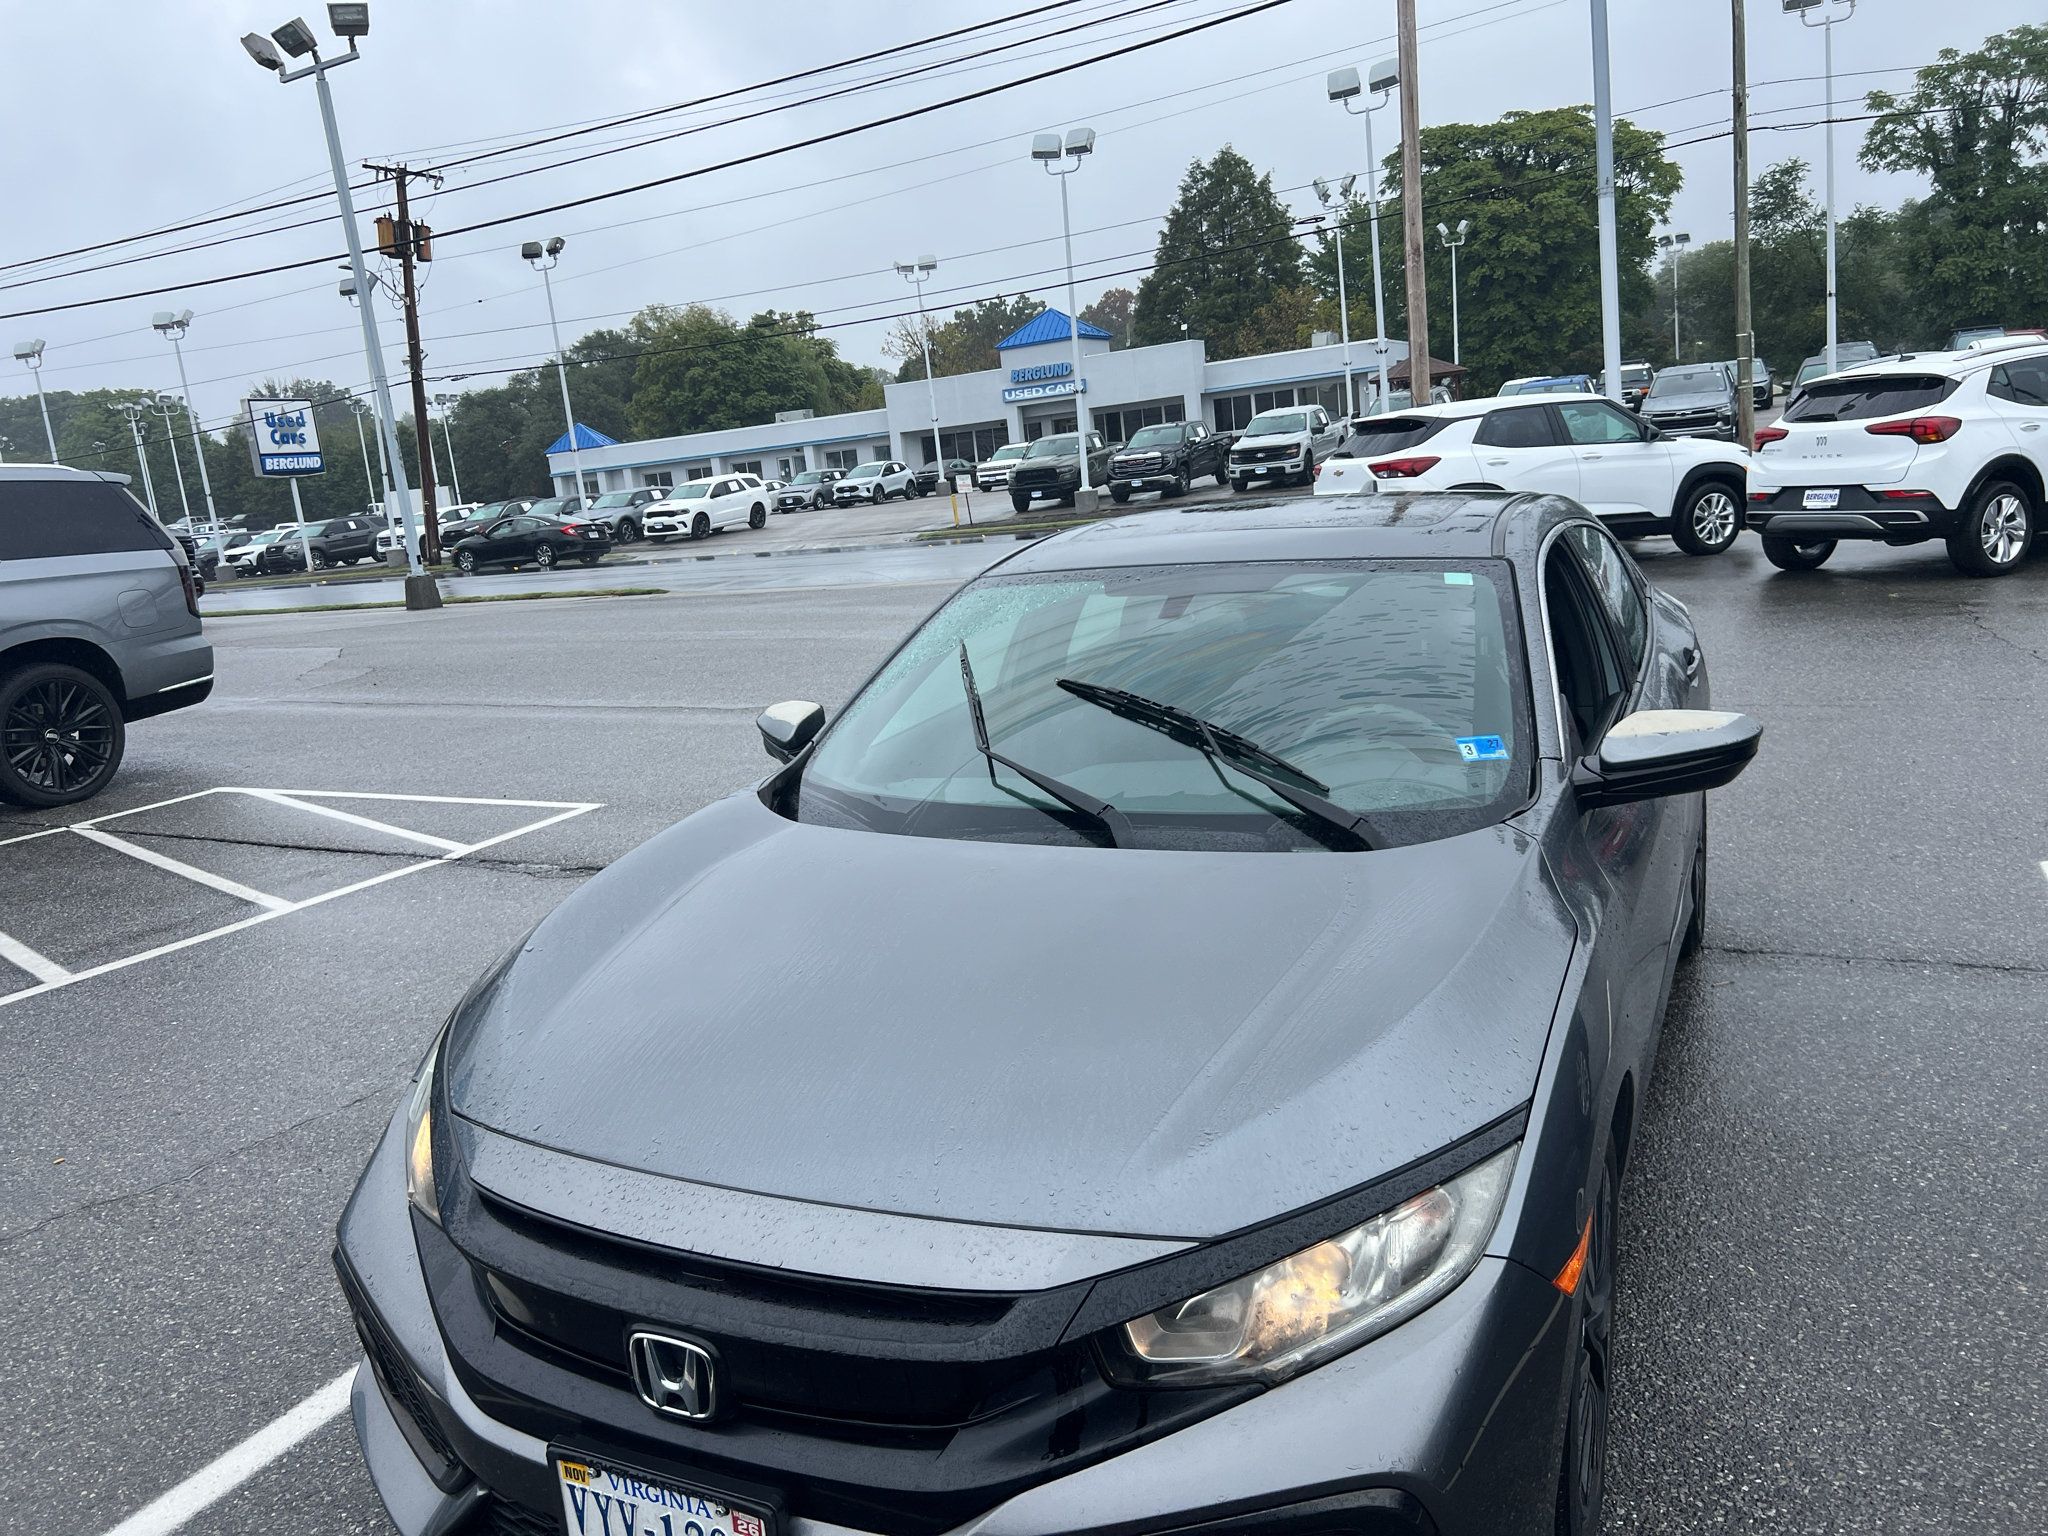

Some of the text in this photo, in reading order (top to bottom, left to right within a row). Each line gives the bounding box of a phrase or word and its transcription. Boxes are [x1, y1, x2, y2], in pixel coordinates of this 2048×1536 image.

[1010, 362, 1072, 383] BERGLUND
[1004, 387, 1041, 400] USED
[264, 410, 306, 428] Used
[270, 429, 307, 445] Cars
[265, 456, 322, 471] BERGLUND
[1805, 492, 1838, 501] BERGLUND
[1464, 744, 1474, 756] 3
[564, 1465, 587, 1483] NOV
[607, 1472, 714, 1520] VIRGINIA
[566, 1483, 726, 1536] VYV-
[737, 1519, 760, 1536] 26
